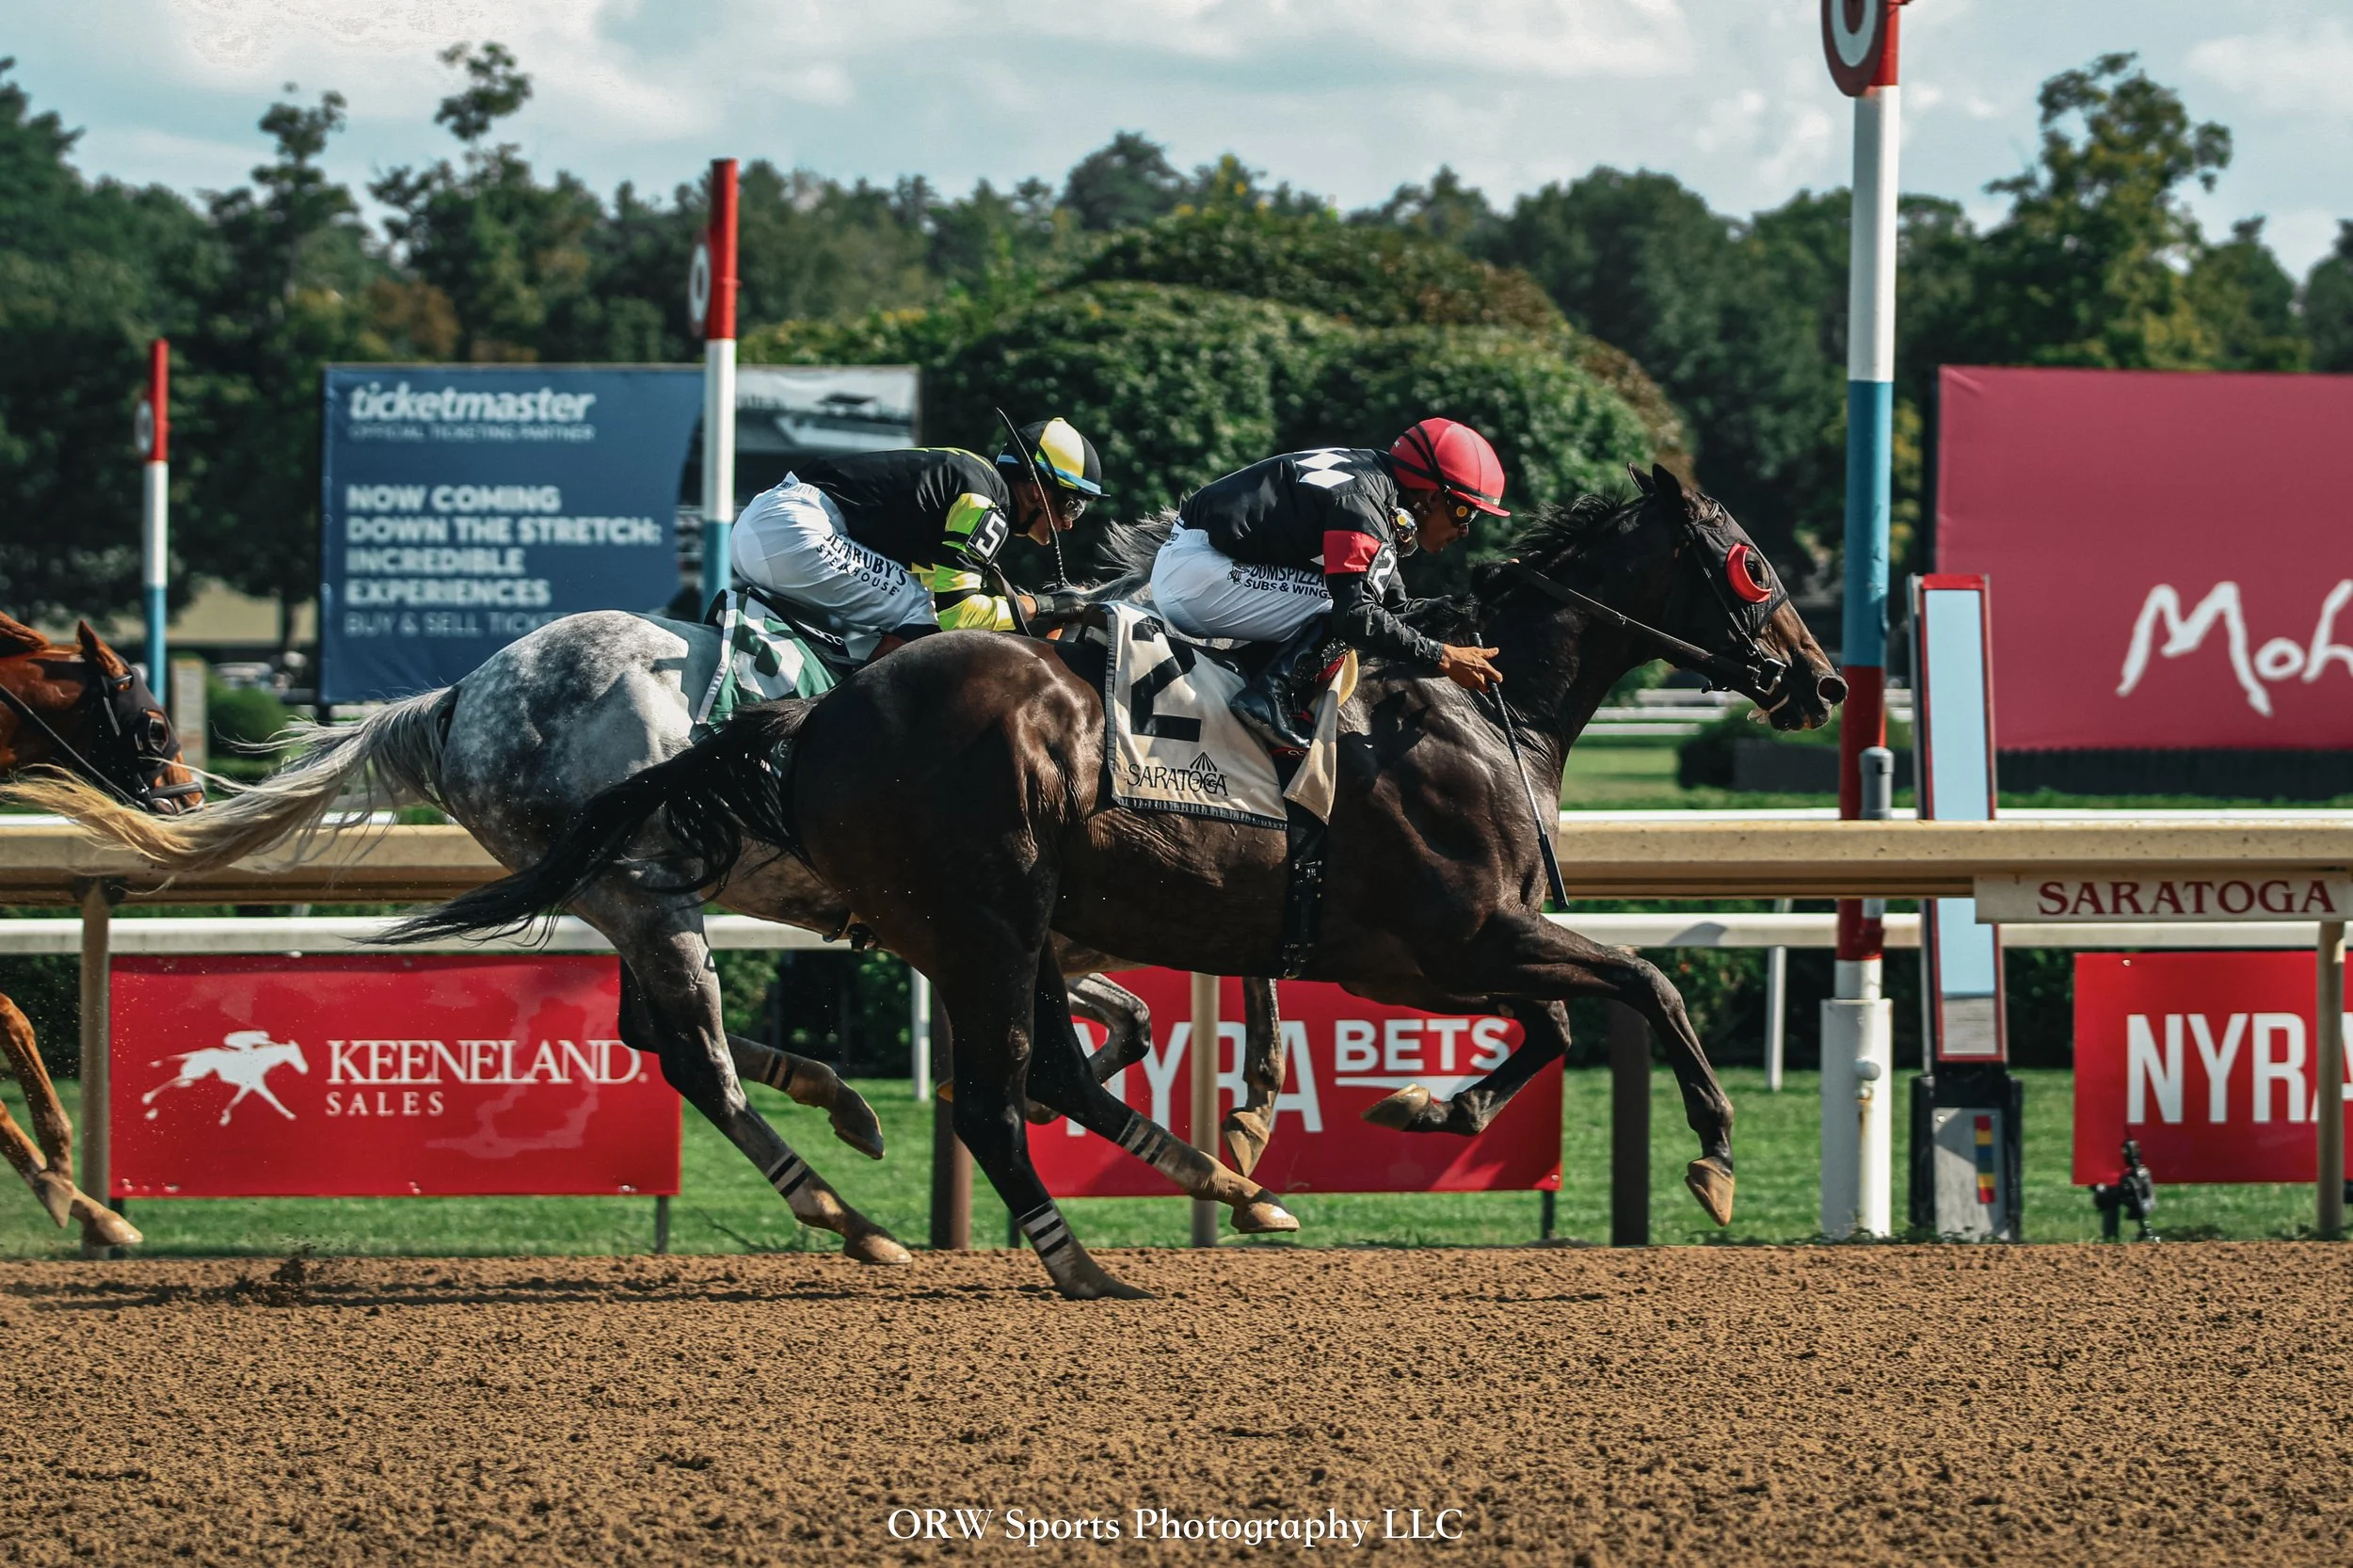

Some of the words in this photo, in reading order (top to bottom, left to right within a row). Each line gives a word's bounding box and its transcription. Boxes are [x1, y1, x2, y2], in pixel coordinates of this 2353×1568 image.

[350, 381, 596, 422] ticketmaster
[347, 486, 425, 511] NOW
[431, 486, 561, 512] COMING
[347, 517, 448, 543] DOWN
[454, 517, 512, 543] THE
[518, 517, 662, 544] STRETCH:
[976, 511, 1006, 557] 5
[346, 548, 525, 575] INCREDIBLE
[1373, 549, 1395, 595] 2
[345, 579, 552, 605] EXPERIENCES
[1244, 579, 1277, 591] SUBS
[1279, 582, 1289, 592] &
[1292, 584, 1332, 599] WING
[344, 612, 397, 637] BUY
[398, 612, 418, 637] &
[424, 612, 484, 637] SELL
[1131, 616, 1201, 742] 2
[1127, 763, 1228, 796] SARATOGA
[2038, 880, 2335, 914] SARATOGA
[1335, 1017, 1510, 1072] BETS
[2127, 1013, 2353, 1123] NYR
[326, 1092, 444, 1115] SALES
